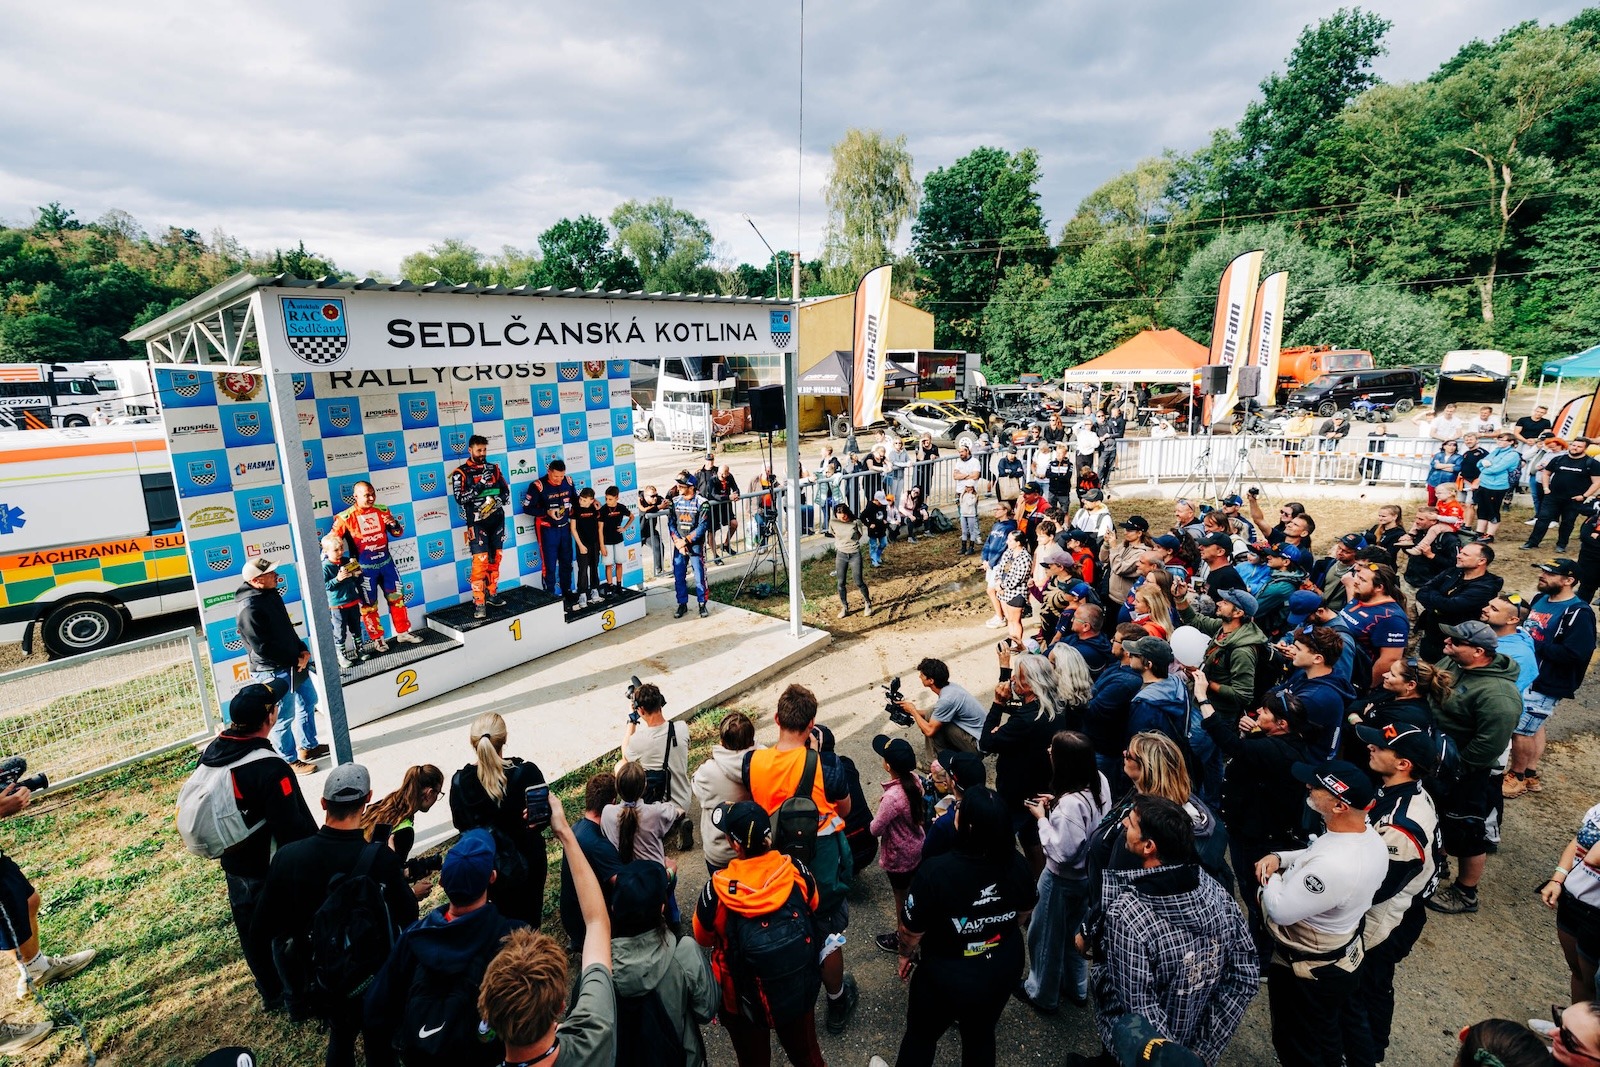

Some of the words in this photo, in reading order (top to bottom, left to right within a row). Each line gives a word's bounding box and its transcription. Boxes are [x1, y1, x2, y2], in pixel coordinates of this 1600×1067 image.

[287, 299, 320, 310] Autoklub
[289, 311, 320, 322] RAC
[290, 323, 342, 336] Sedlčany
[387, 315, 646, 348] SEDLČANSKÁ
[656, 322, 758, 343] KOTLINA
[329, 363, 546, 389] RALLYCROSS
[247, 460, 275, 470] HASMAN
[313, 500, 329, 510] JR
[195, 511, 226, 523] BÍLEK
[154, 535, 186, 549] SLU
[18, 540, 141, 568] ZÁCHRANNÁ
[264, 544, 290, 554] DEŠTNO
[395, 555, 415, 565] ETIVO
[206, 593, 235, 605] GARN
[601, 609, 616, 631] 3
[509, 619, 522, 641] 1
[396, 669, 419, 697] 2
[1582, 867, 1600, 882] AMERIC
[952, 911, 1016, 933] VALTORRO
